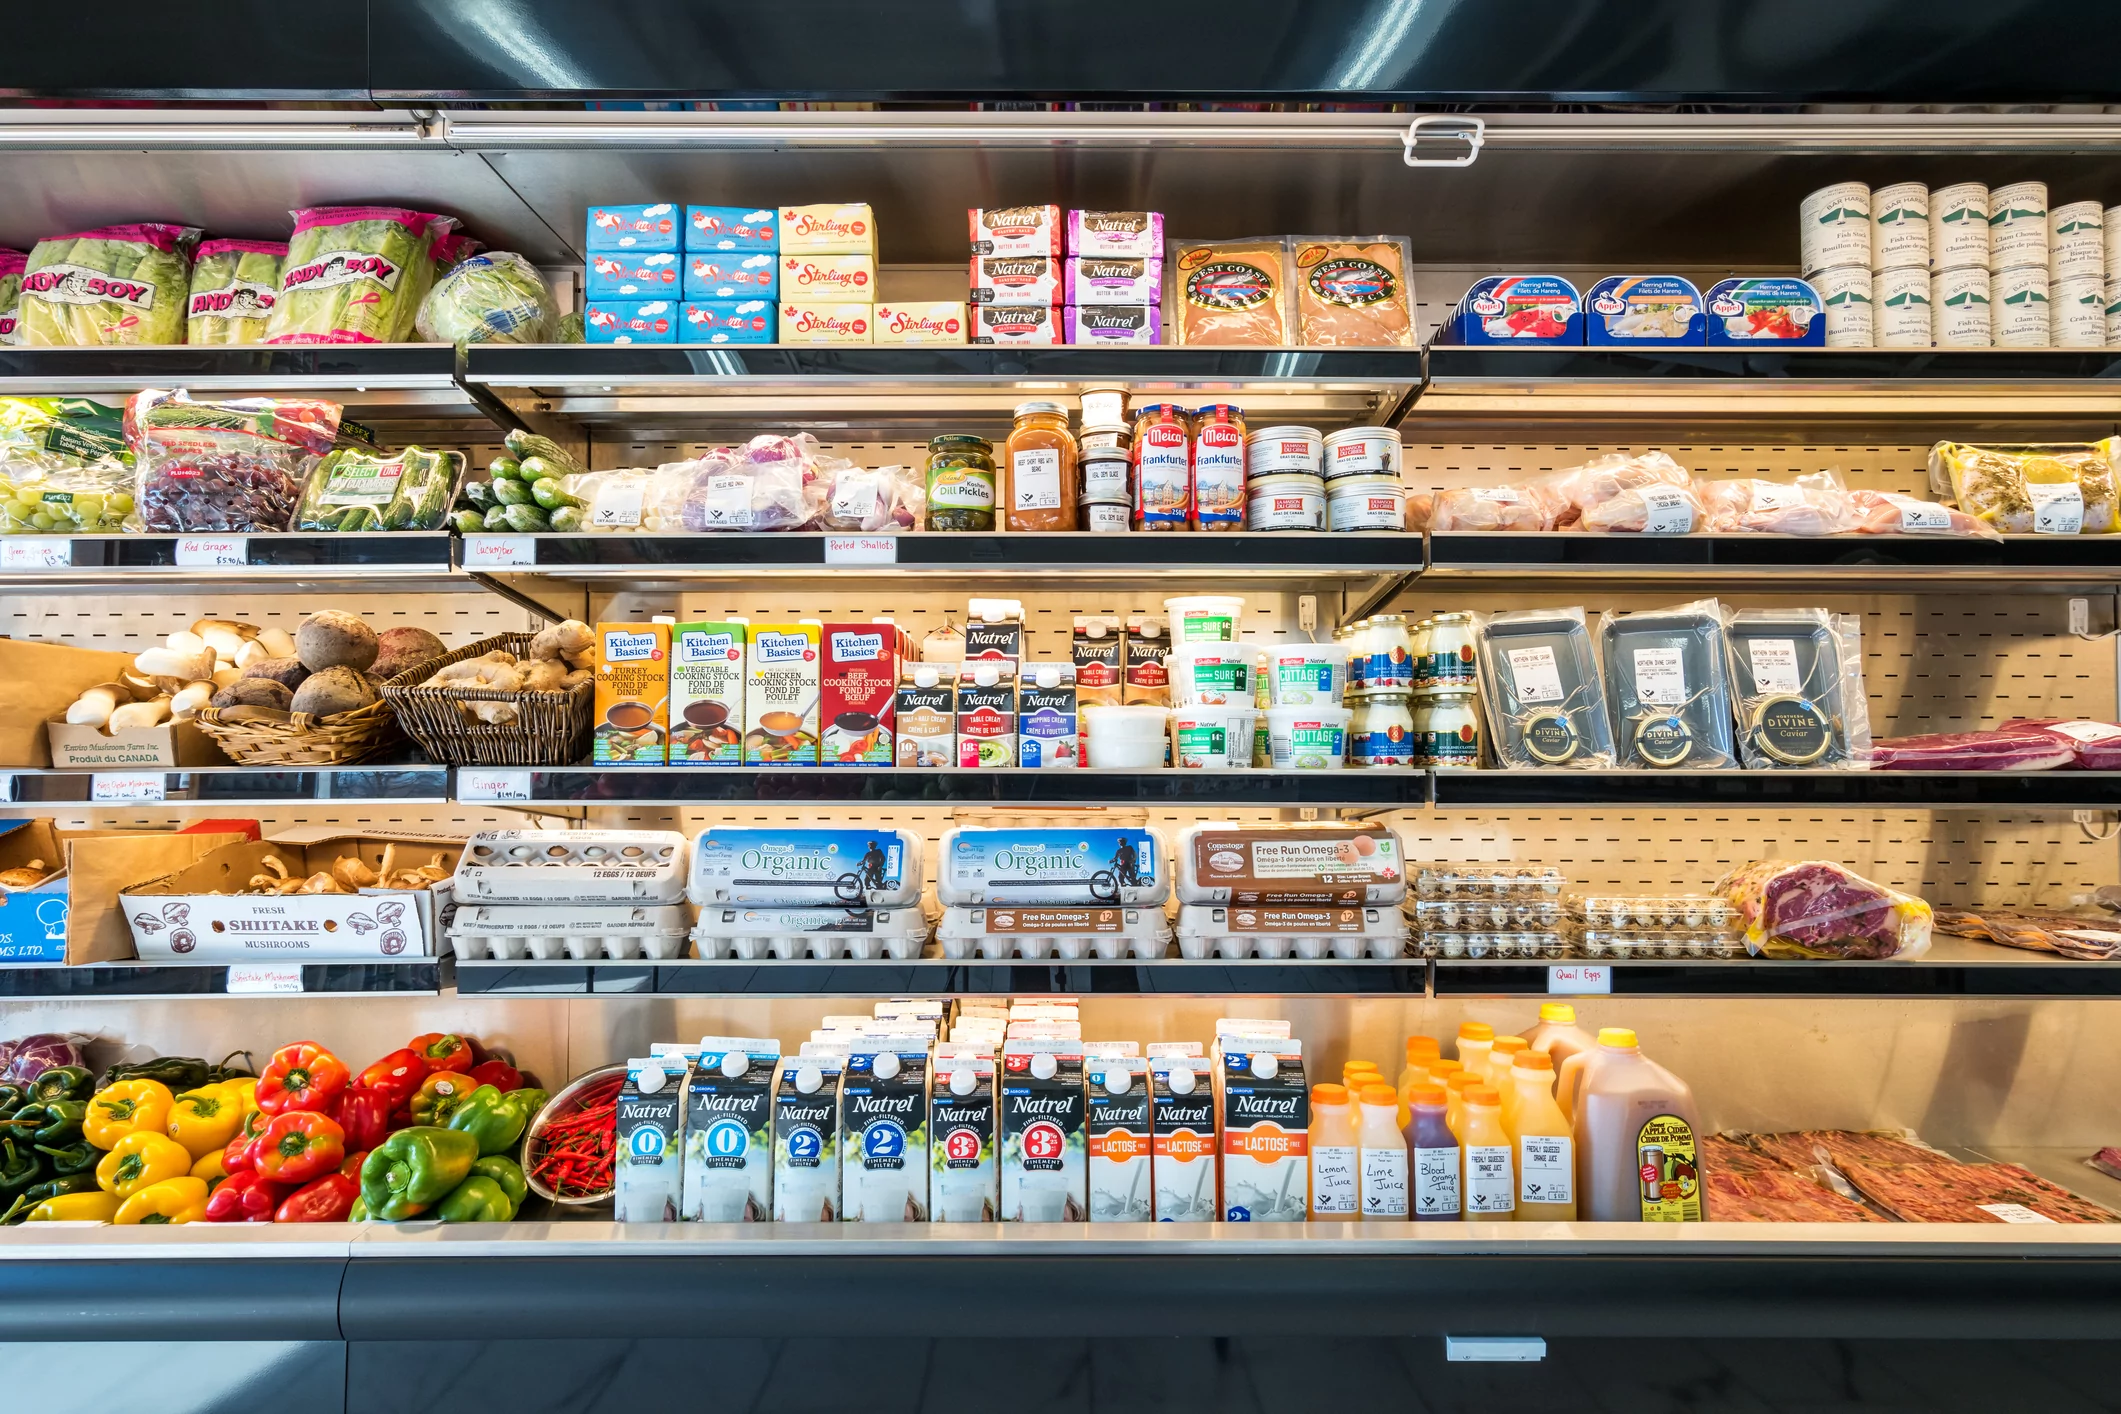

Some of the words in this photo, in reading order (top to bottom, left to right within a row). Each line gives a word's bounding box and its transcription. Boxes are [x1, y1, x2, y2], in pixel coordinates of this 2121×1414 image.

[990, 211, 1038, 227] Natrel
[1096, 218, 1136, 232] Natrel
[796, 215, 850, 237] Stirling
[345, 257, 394, 280] BOY
[993, 261, 1038, 276] Natrel
[1092, 264, 1134, 277] Natrel
[1189, 264, 1224, 285] WEST
[1226, 264, 1268, 283] COAST
[1312, 261, 1345, 281] WEST
[1349, 260, 1390, 279] COAST
[798, 264, 852, 287] Stirling
[1475, 302, 1501, 313] Appel
[1597, 302, 1623, 313] Appel
[1714, 303, 1741, 314] Appel
[796, 311, 851, 335] Stirling
[993, 310, 1037, 324] Natrel
[1092, 315, 1134, 328] Natrel
[890, 312, 944, 335] Stirling
[1150, 429, 1182, 443] Meica
[1205, 429, 1237, 443] Meica
[1142, 454, 1187, 466] Frankfurter
[1197, 454, 1242, 466] Frankfurter
[382, 465, 400, 476] ONE
[967, 481, 986, 489] Kosher
[940, 486, 957, 495] Dill
[959, 486, 989, 499] Pickles
[184, 543, 199, 552] Red
[203, 542, 233, 556] Grapes
[830, 539, 855, 551] Peeled
[861, 539, 894, 550] Shallots
[1202, 623, 1220, 632] SURE
[609, 637, 653, 648] Kitchen
[686, 637, 729, 648] Kitchen
[761, 637, 804, 648] Kitchen
[835, 637, 879, 648] Kitchen
[969, 631, 1013, 645] Natrel
[615, 648, 649, 657] Basics
[691, 648, 725, 657] Basics
[766, 648, 801, 658] Basics
[841, 648, 875, 658] Basics
[1076, 646, 1114, 658] Natrel
[1131, 646, 1170, 657] Natrel
[596, 674, 635, 682] COOKING
[636, 673, 665, 682] STOCK
[673, 672, 712, 680] COOKING
[713, 672, 740, 680] STOCK
[1214, 670, 1234, 680] SURE
[1280, 669, 1318, 682] COTTAGE
[612, 681, 635, 689] FOND
[748, 679, 787, 687] COOKING
[789, 679, 817, 687] STOCK
[823, 679, 862, 687] COOKING
[864, 679, 892, 687] STOCK
[904, 694, 944, 706] Natrel
[964, 694, 1005, 706] Natrel
[1027, 695, 1066, 706] Natrel
[1051, 716, 1067, 724] CREAM
[1768, 717, 1815, 727] DIVINE
[1294, 730, 1332, 742] COTTAGE
[1535, 729, 1566, 737] DIVINE
[1780, 730, 1808, 738] Caviar
[64, 743, 88, 752] Enviro
[89, 743, 125, 751] Mushroom
[69, 754, 103, 764] Produit
[105, 754, 116, 763] du
[118, 755, 159, 763] CANADA
[472, 777, 508, 794] Ginger
[761, 844, 794, 854] Omega-3
[1013, 844, 1045, 853] Omega-3
[1207, 842, 1244, 850] Conestoga
[1256, 846, 1278, 855] Free
[1281, 846, 1301, 855] Run
[1303, 845, 1350, 857] Omega-3
[742, 849, 831, 875] Organic
[994, 849, 1084, 875] Organic
[779, 913, 828, 927] Organic
[1022, 913, 1039, 921] Free
[1040, 913, 1054, 921] Run
[1055, 913, 1089, 922] Omega-3
[229, 920, 319, 931] SHIITAKE
[18, 945, 45, 956] LTD.
[245, 940, 310, 949] MUSHROOMS
[1556, 968, 1578, 981] Quail
[1584, 968, 1601, 982] Eggs
[697, 1093, 758, 1112] Natrel
[853, 1095, 914, 1113] Natrel
[1012, 1095, 1073, 1114] Natrel
[1235, 1096, 1298, 1114] Natrel
[621, 1103, 673, 1118] Natrel
[779, 1105, 829, 1120] Natrel
[937, 1107, 986, 1122] Natrel
[1093, 1106, 1143, 1122] Natrel
[1157, 1106, 1208, 1122] Natrel
[1102, 1140, 1137, 1152] LACTOSE
[1166, 1140, 1202, 1152] LACTOSE
[1245, 1137, 1289, 1152] LACTOSE
[1318, 1164, 1348, 1174] Lemon
[1366, 1164, 1395, 1177] Lime
[1420, 1162, 1445, 1175] Blood
[1323, 1175, 1352, 1187] Juice
[1374, 1178, 1404, 1190] Juice
